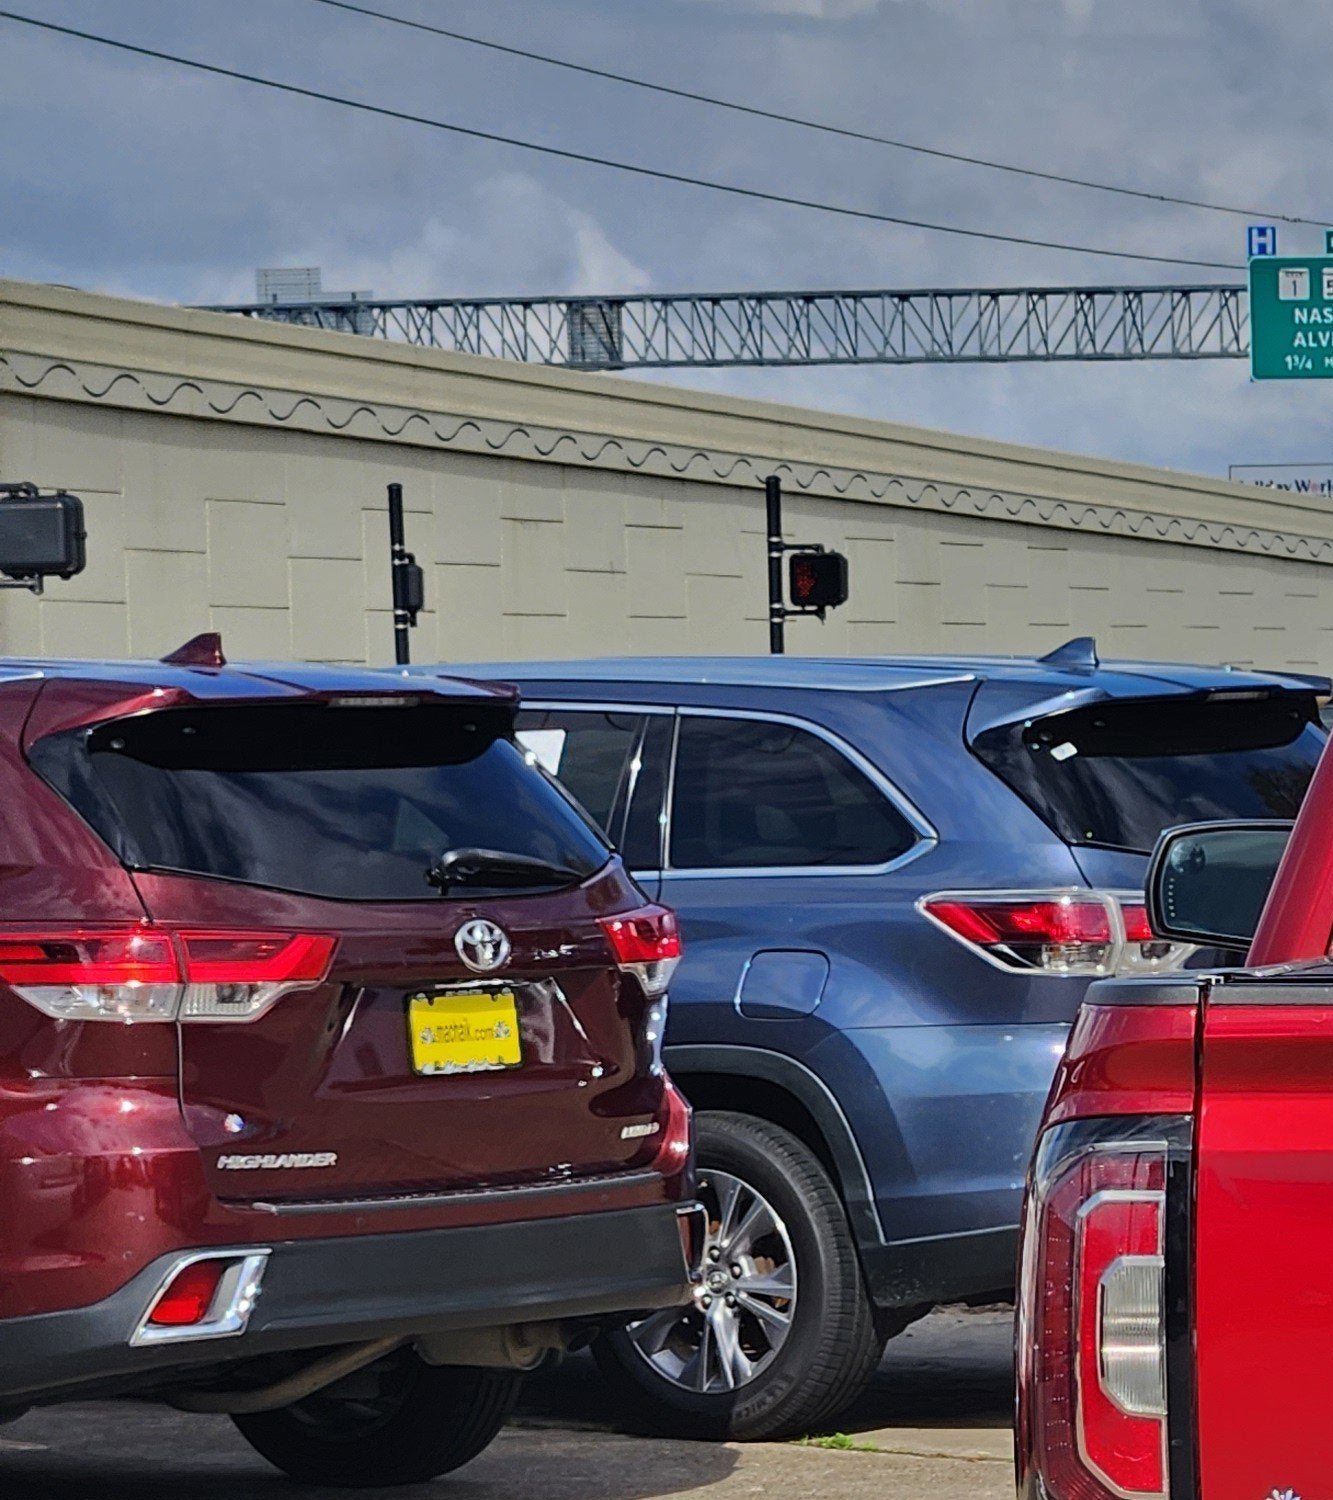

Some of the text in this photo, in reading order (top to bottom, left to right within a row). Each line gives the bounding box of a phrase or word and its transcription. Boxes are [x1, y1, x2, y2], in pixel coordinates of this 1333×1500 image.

[1251, 226, 1273, 256] H
[1291, 279, 1298, 297] 1
[217, 1152, 338, 1170] HIGHLANDER
